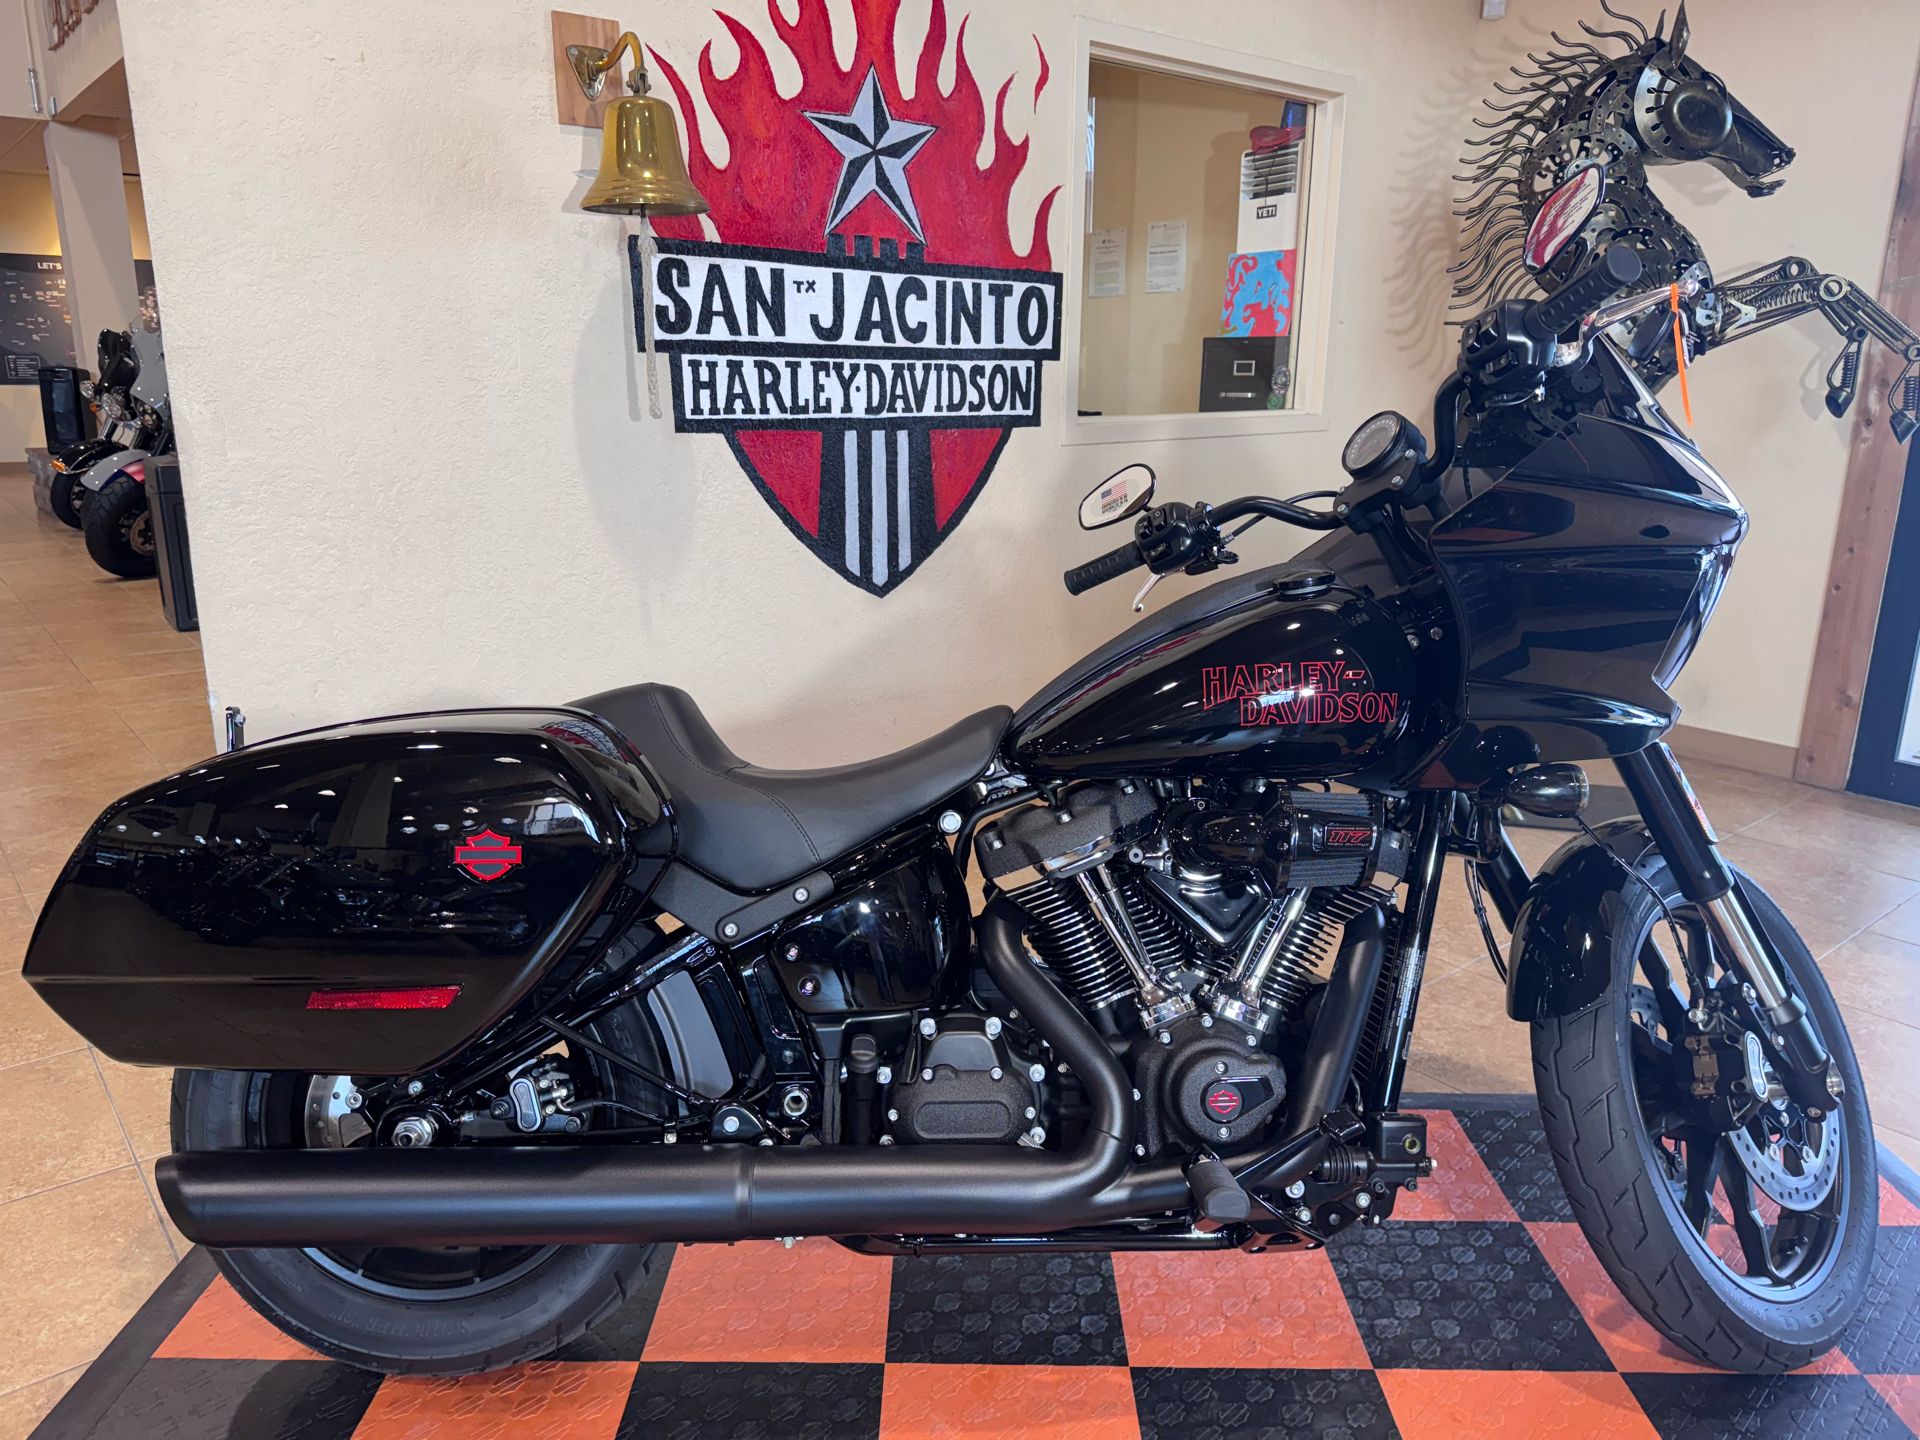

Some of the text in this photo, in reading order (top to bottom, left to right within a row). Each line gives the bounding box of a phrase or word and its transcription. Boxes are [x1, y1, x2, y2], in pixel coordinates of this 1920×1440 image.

[1257, 206, 1276, 218] YETI
[37, 262, 62, 270] LET'S
[655, 257, 1049, 347] SAN TX JACINTO
[1202, 661, 1366, 710] HARLEY-
[1239, 692, 1398, 727] DAVIDSON
[1329, 830, 1371, 843] 117
